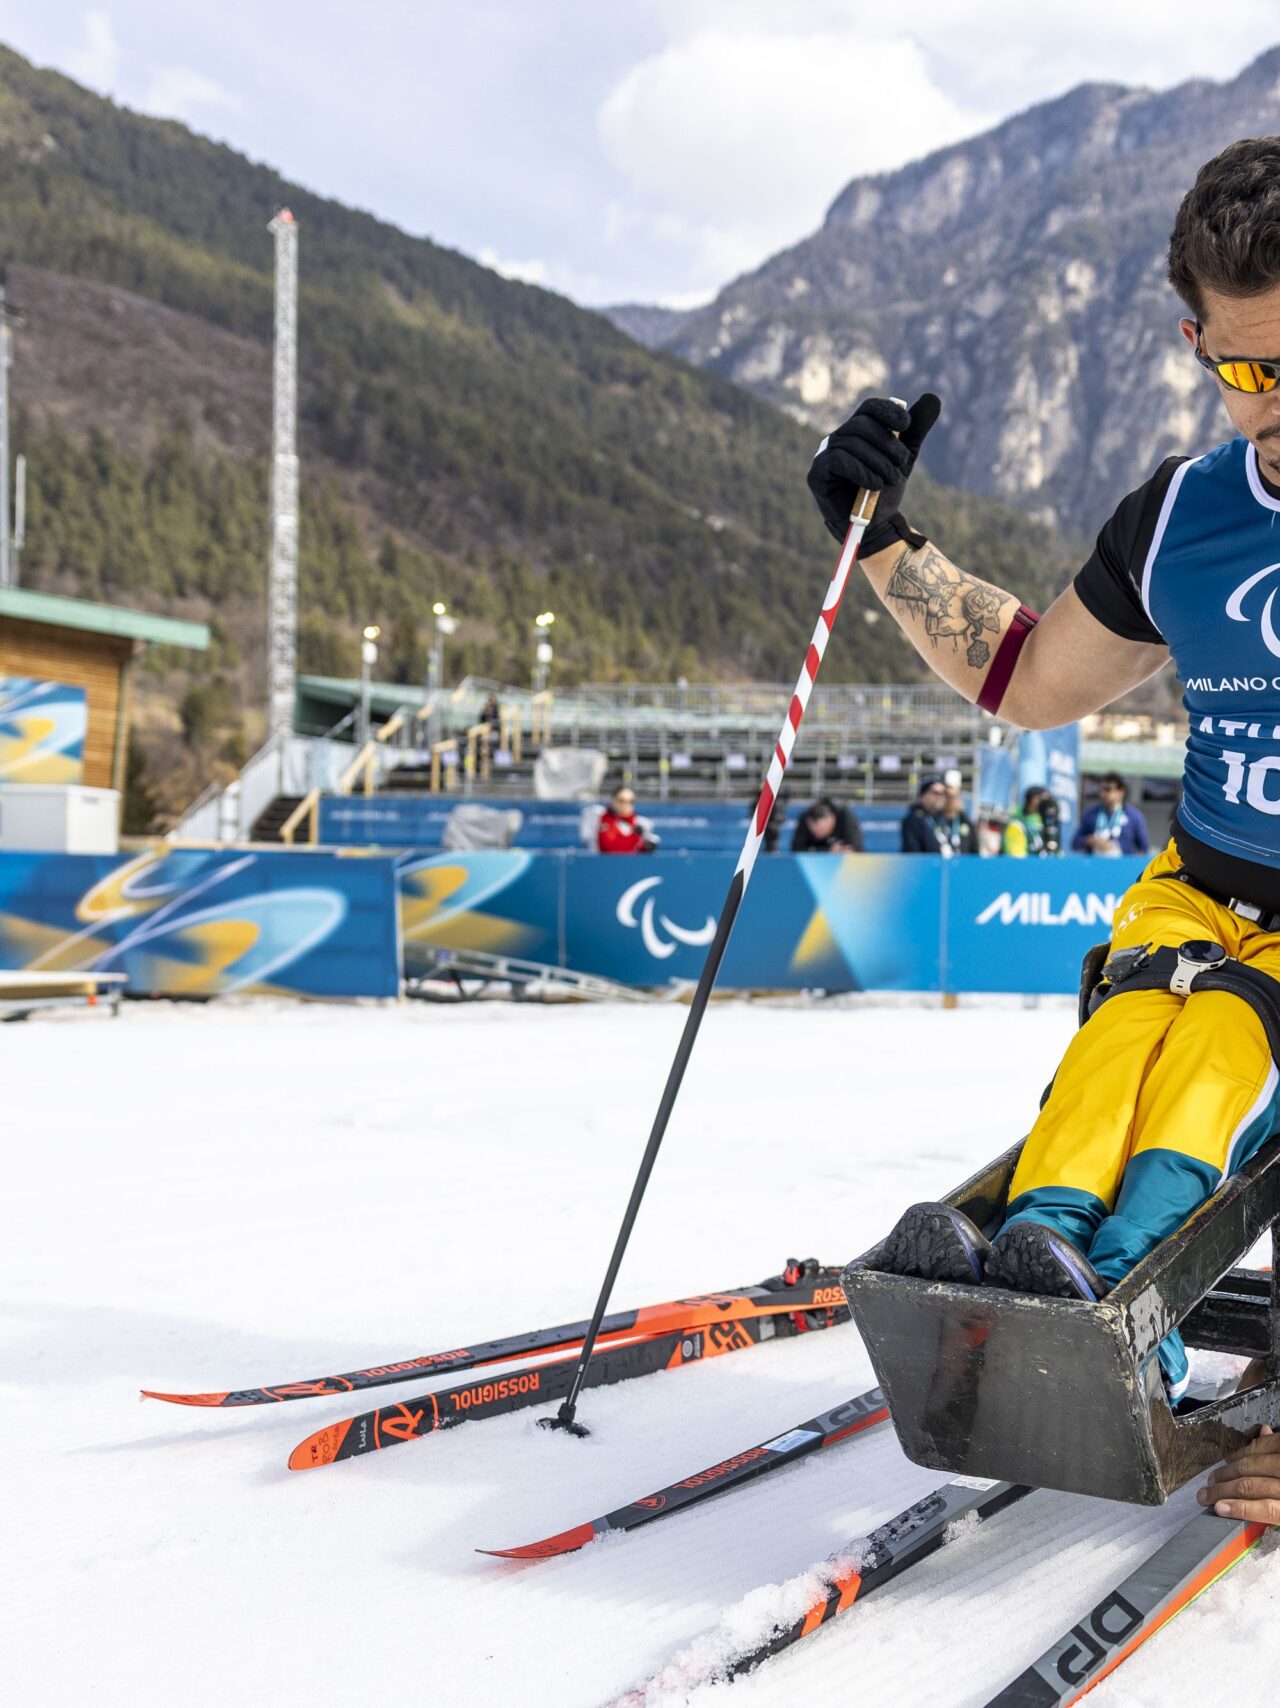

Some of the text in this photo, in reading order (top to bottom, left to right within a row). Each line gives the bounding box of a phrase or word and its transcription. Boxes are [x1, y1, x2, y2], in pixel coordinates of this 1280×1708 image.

[1186, 677, 1267, 692] MILANO
[975, 892, 1124, 926] MILAN
[354, 1349, 472, 1378] ROSSIGNOL
[449, 1372, 540, 1411] ROSSIGNOL
[671, 1447, 770, 1490] ROSSIGNOL
